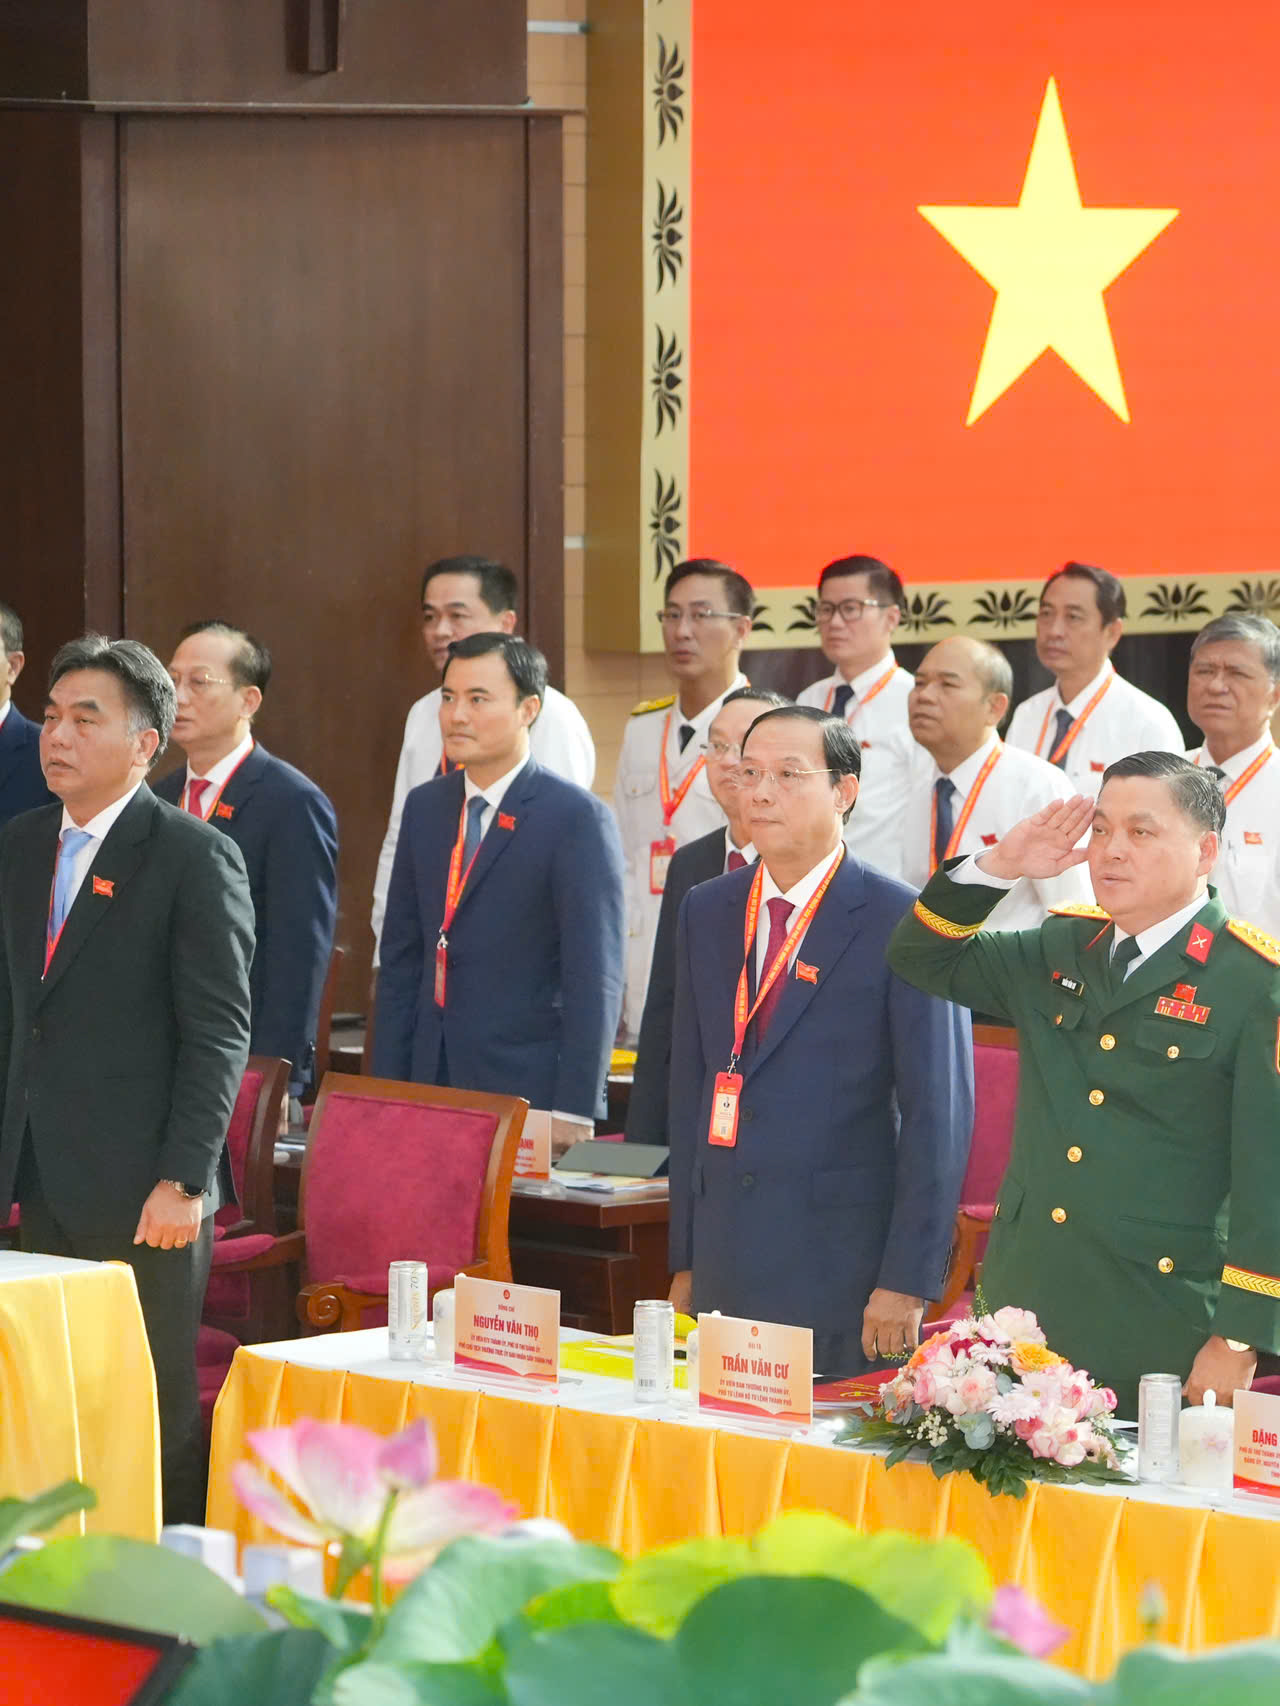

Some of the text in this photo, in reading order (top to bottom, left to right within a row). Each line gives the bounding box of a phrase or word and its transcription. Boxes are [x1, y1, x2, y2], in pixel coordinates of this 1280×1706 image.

[474, 1314, 539, 1341] NGUYỄN VĂN THỌ
[722, 1353, 789, 1379] TRẦN VĂN CƯ
[1252, 1428, 1277, 1447] ĐẶNG
